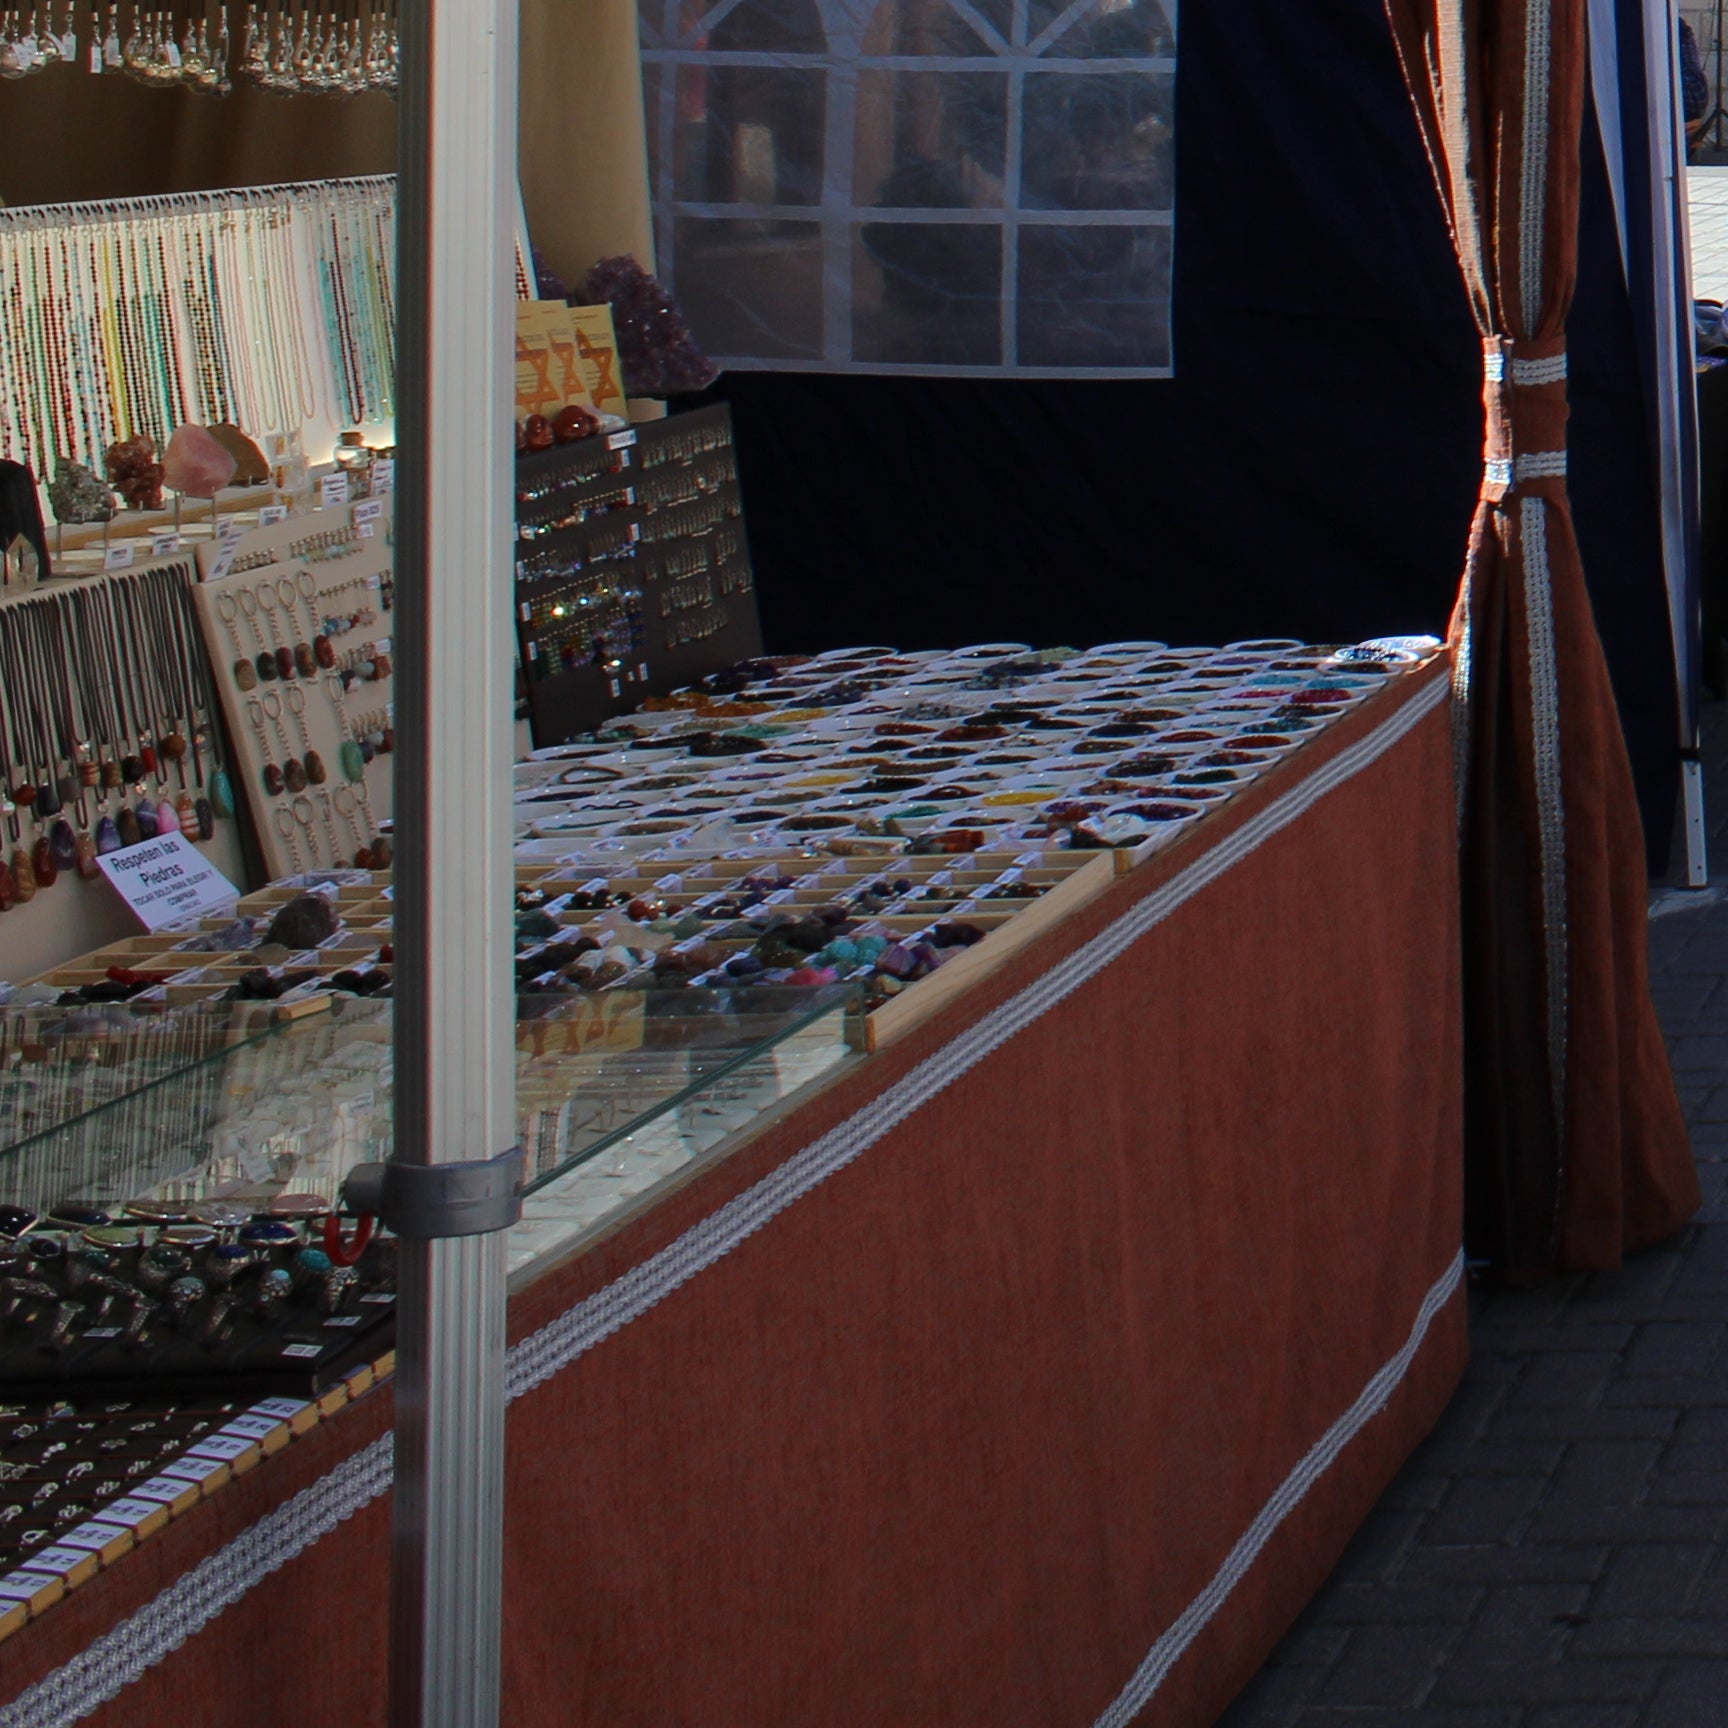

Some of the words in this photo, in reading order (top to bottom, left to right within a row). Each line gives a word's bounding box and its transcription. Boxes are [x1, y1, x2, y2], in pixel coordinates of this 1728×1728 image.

[110, 846, 163, 872] Respeten
[160, 840, 181, 855] las
[139, 863, 185, 888] Piedras
